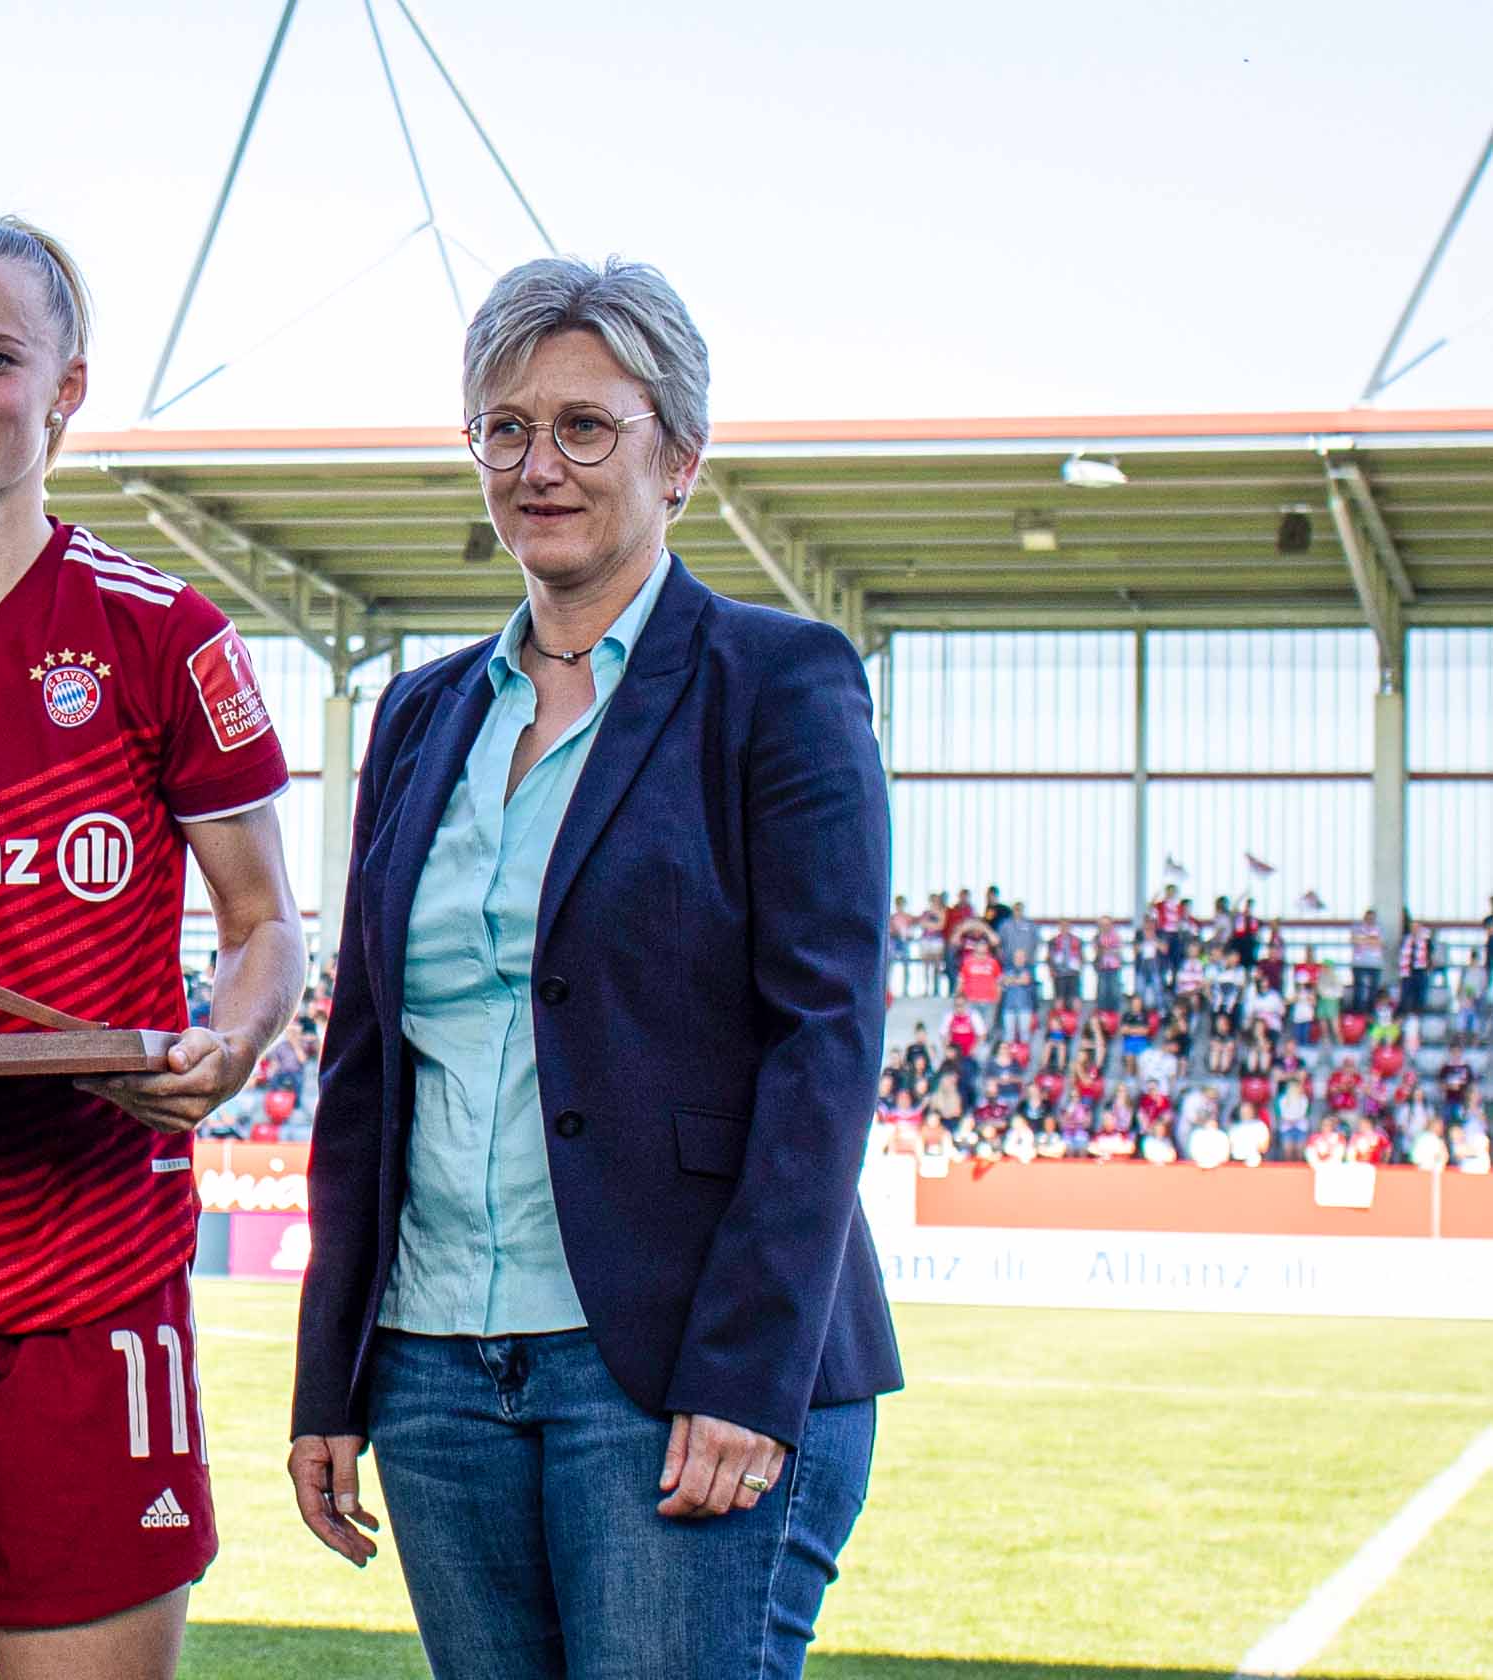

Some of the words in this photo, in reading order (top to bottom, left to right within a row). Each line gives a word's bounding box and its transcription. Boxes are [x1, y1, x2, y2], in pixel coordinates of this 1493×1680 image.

[55, 671, 95, 691] BAYERN
[1086, 1251, 1250, 1288] Allianz
[111, 1325, 189, 1457] 11
[141, 1512, 190, 1528] adidas
